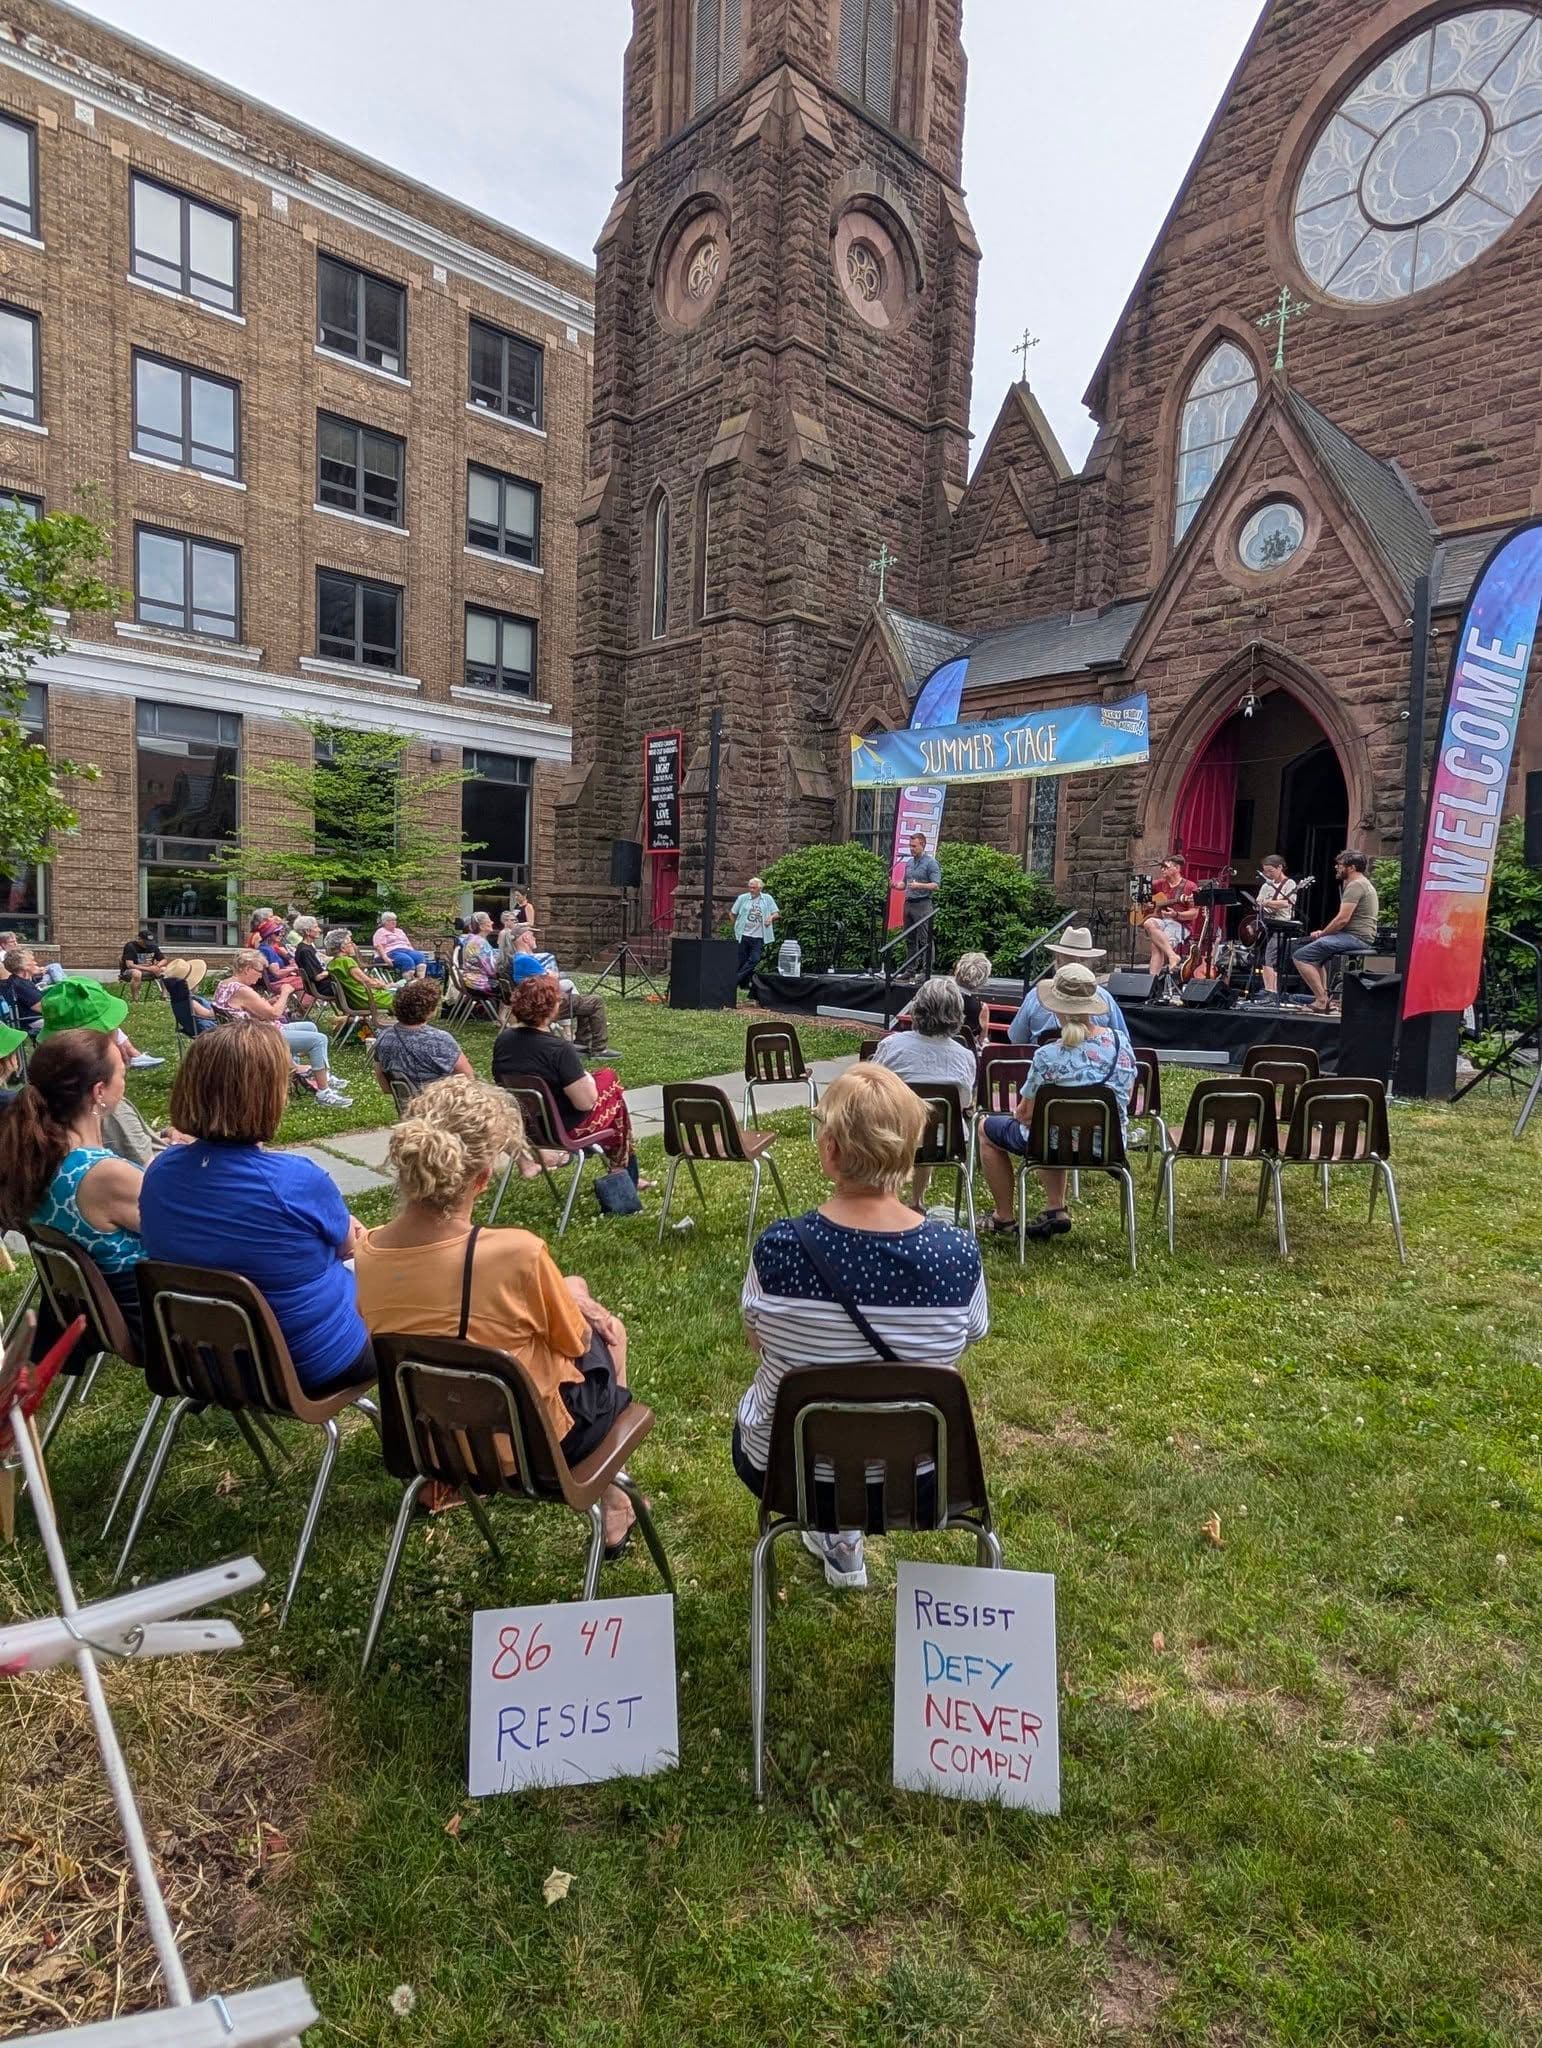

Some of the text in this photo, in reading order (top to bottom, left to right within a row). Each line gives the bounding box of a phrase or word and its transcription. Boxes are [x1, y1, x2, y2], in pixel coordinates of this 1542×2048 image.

[920, 724, 1057, 774] SUMMER STAGE
[1424, 626, 1528, 893] WELCOME
[914, 1589, 1016, 1632] RESIST
[491, 1612, 623, 1680] 86 47
[923, 1640, 1013, 1690] DEFY
[925, 1693, 1043, 1747] NEVER
[929, 1738, 1033, 1783] COMPLY
